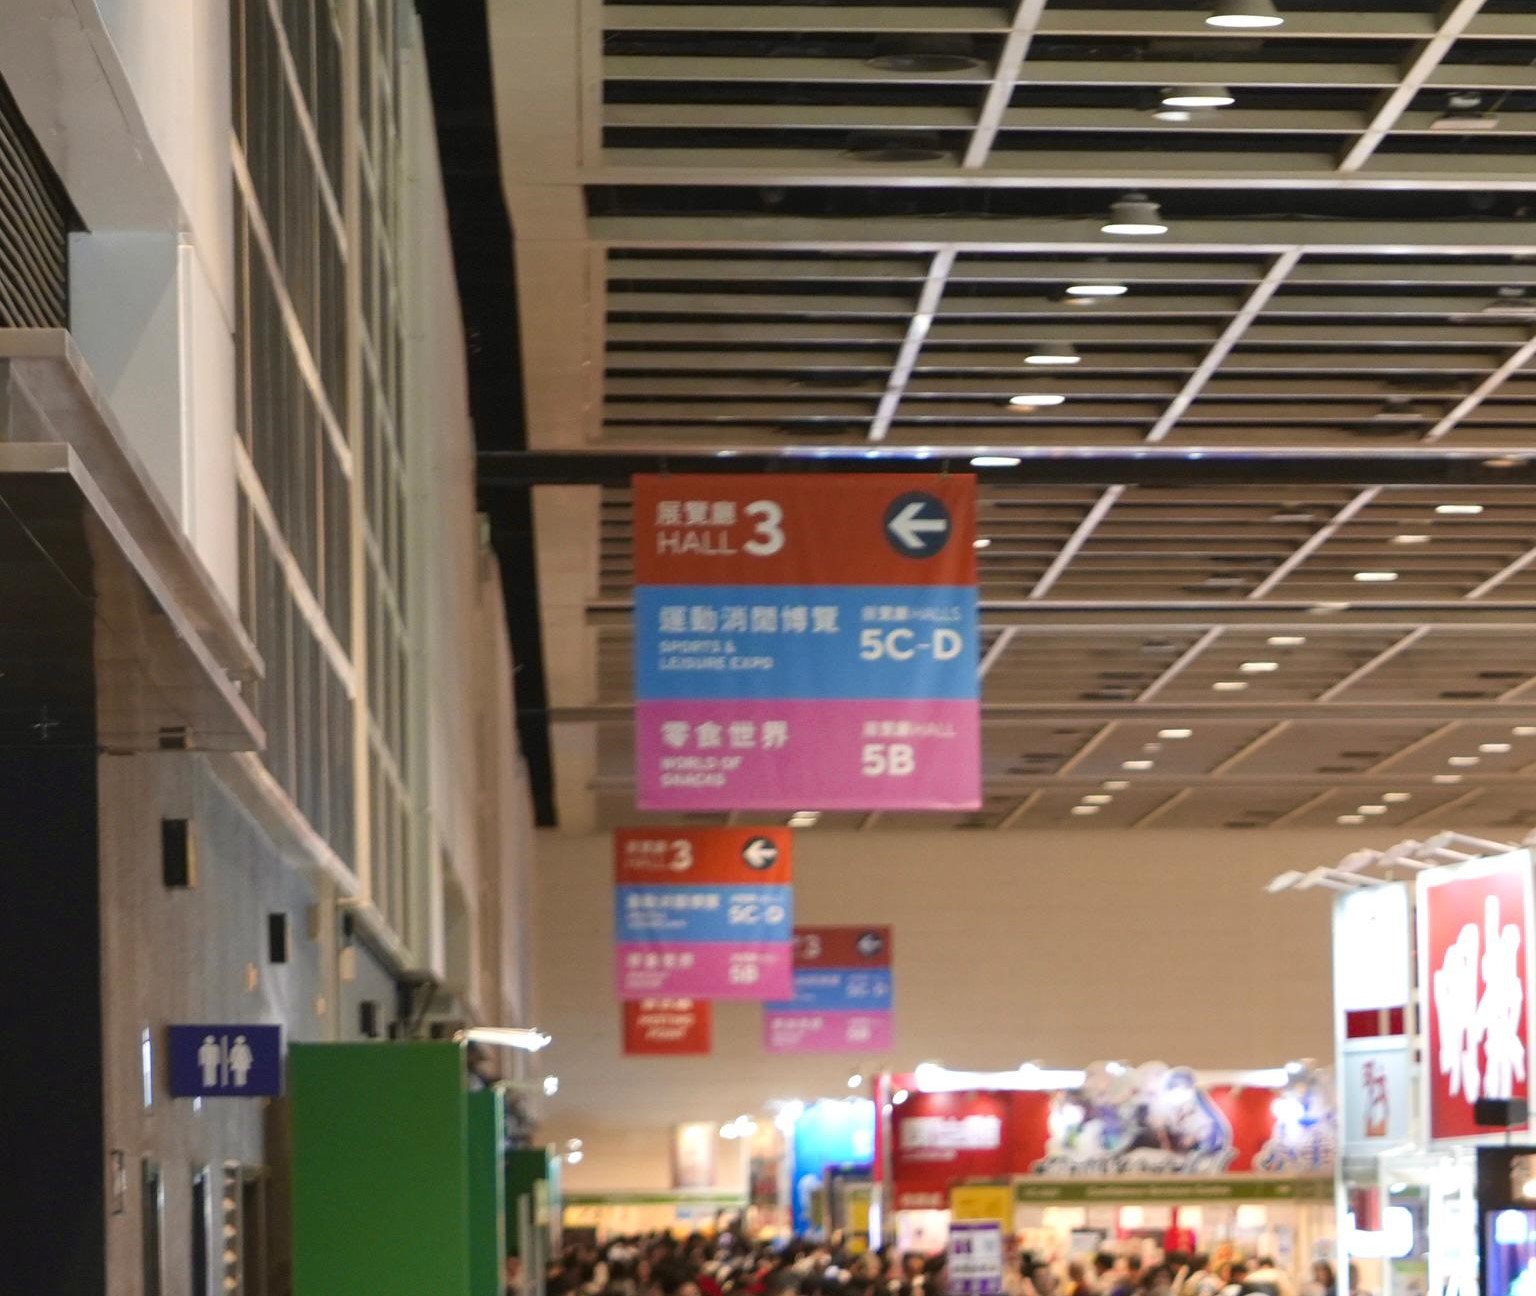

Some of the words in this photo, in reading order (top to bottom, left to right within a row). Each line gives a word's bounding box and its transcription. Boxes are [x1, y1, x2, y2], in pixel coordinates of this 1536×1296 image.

[655, 499, 737, 527] 展覽廳
[743, 499, 787, 557] 3
[655, 529, 738, 556] HALL
[858, 628, 964, 661] 5C-D
[660, 720, 789, 750] 零食世界
[861, 743, 916, 777] 5B
[671, 839, 693, 872] 3
